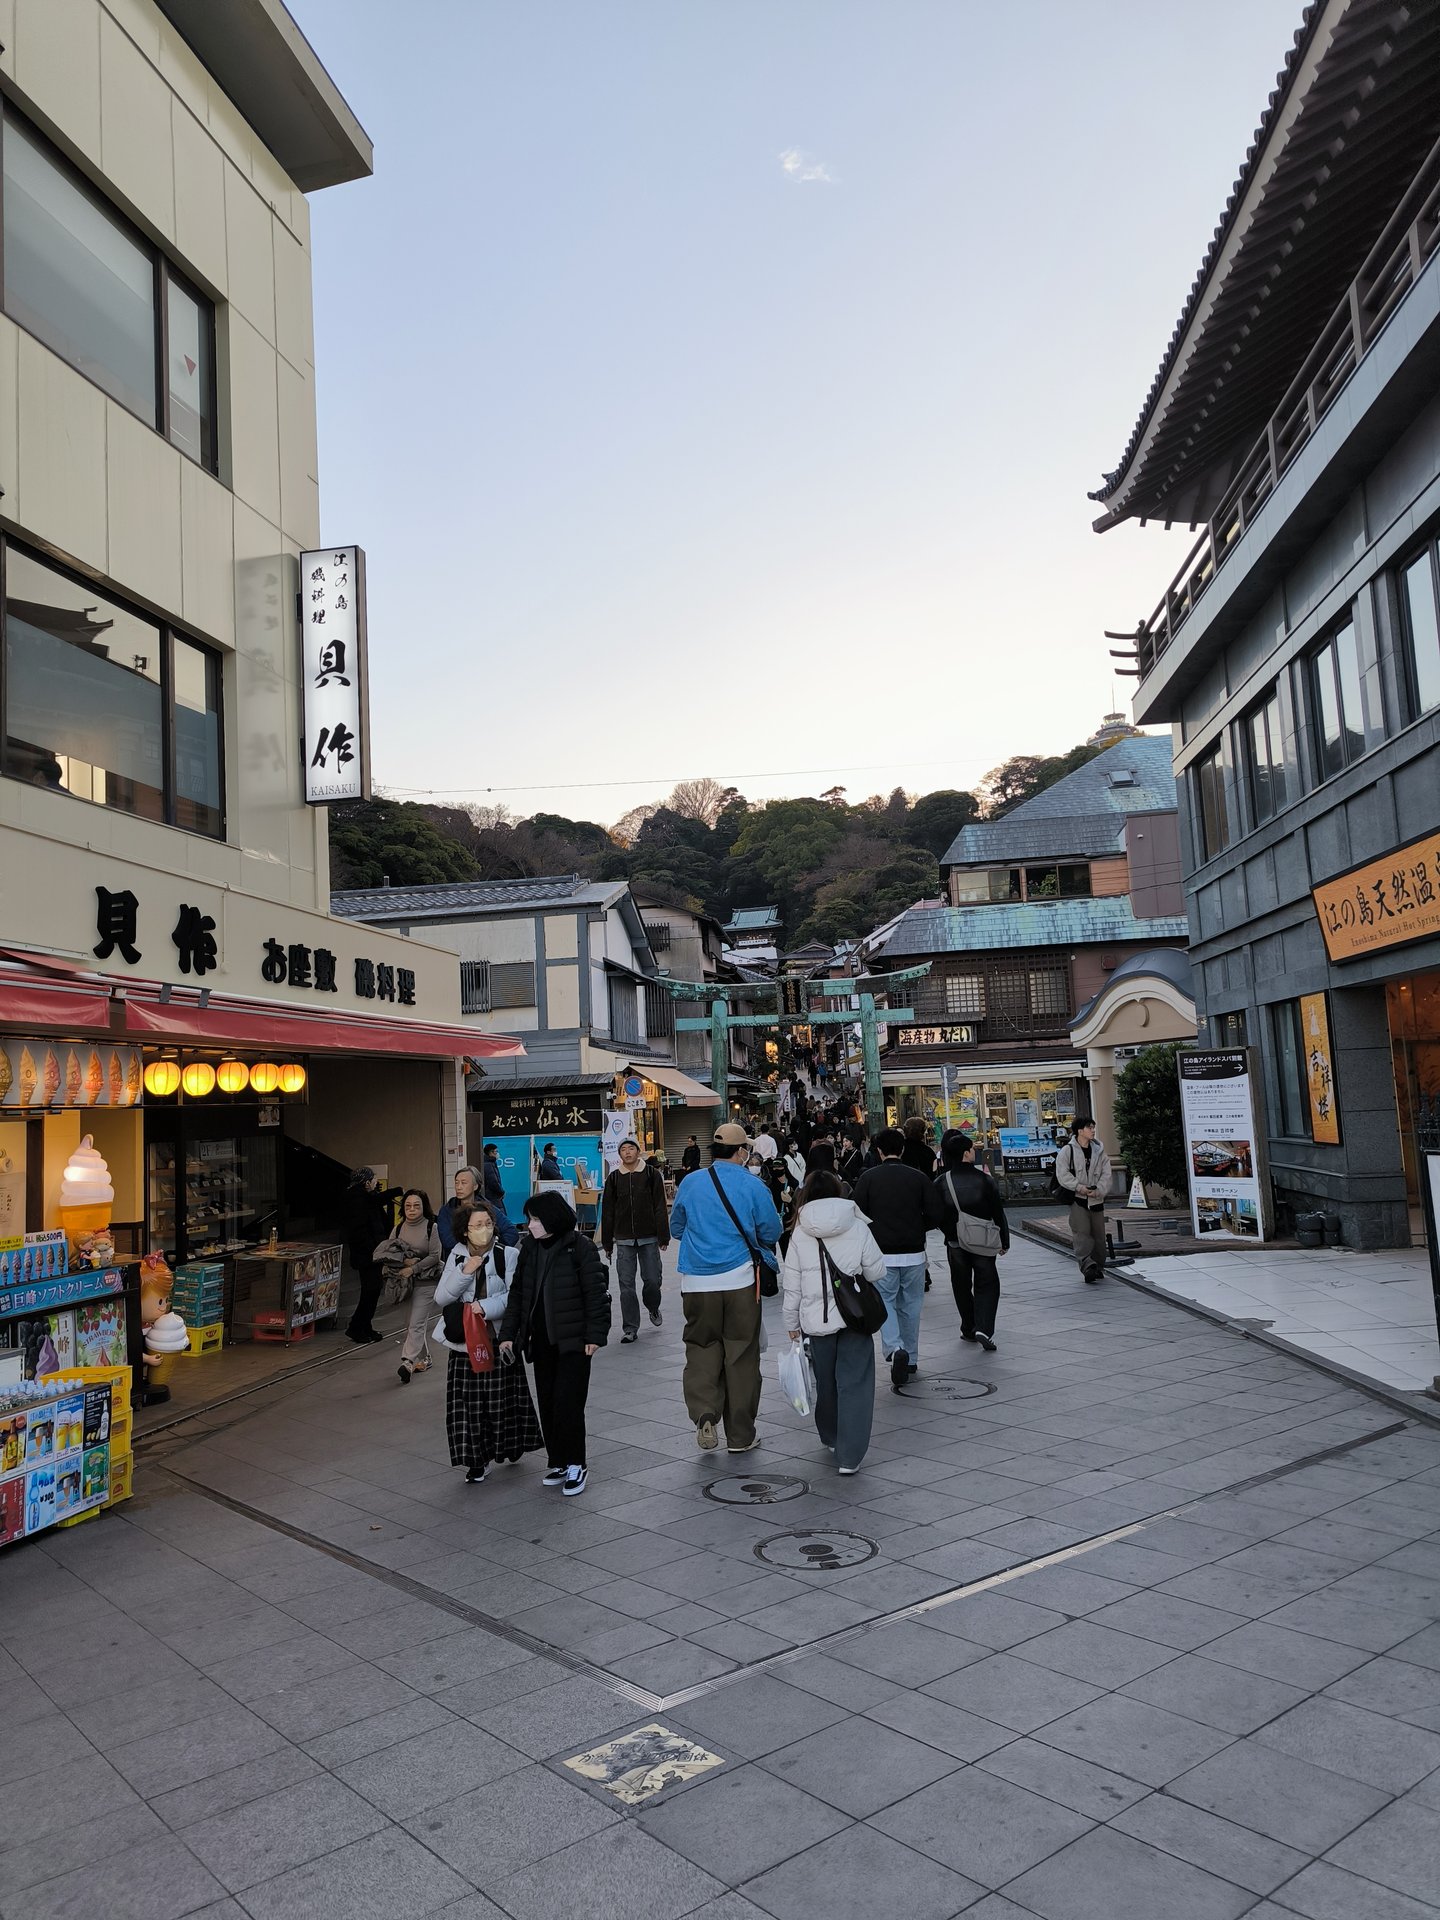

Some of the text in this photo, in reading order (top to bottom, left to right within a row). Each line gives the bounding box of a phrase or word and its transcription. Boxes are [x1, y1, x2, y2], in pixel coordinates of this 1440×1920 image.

[333, 553, 349, 610] 江の島
[310, 639, 356, 775] 貝作
[311, 783, 356, 797] KAISAKU
[1322, 851, 1440, 938] 江の島天然温
[1351, 933, 1378, 947] Enoshima
[1378, 924, 1402, 940] Natural
[1402, 920, 1417, 932] Hot
[261, 937, 338, 993] お座敷
[354, 957, 417, 1006] 磯料理
[900, 1029, 935, 1045] 海産物
[939, 1026, 971, 1043] 丸だい
[492, 1106, 589, 1130] 丸だい 仙水
[627, 1099, 644, 1108] ここまで
[14, 1277, 103, 1310] 巨峰ソフトクリーム
